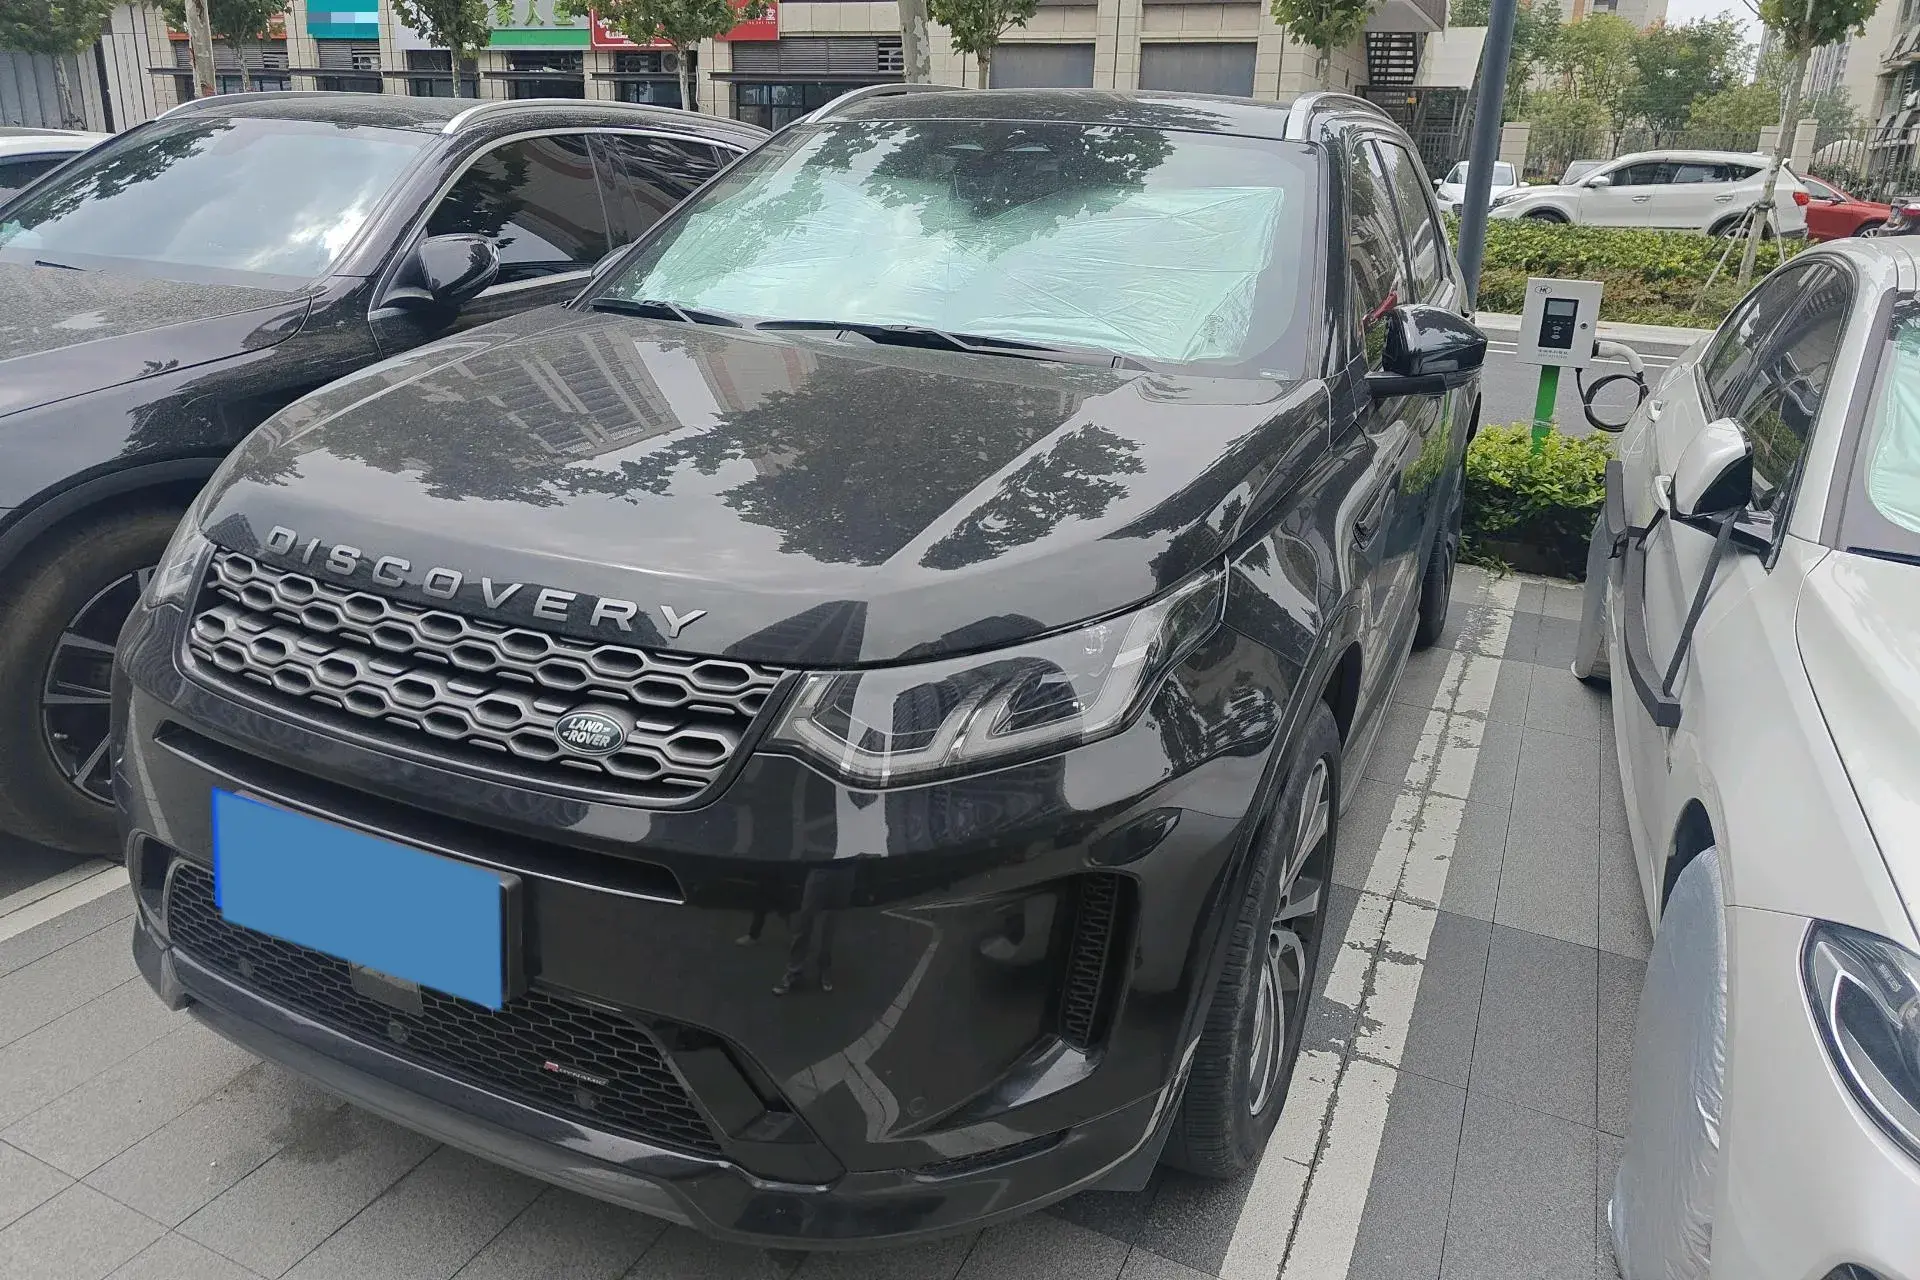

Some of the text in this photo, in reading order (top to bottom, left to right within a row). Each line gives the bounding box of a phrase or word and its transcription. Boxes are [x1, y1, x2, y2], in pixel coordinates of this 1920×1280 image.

[266, 525, 709, 639] DISCOVERY
[568, 717, 604, 734] LAND
[567, 730, 611, 748] ROVER
